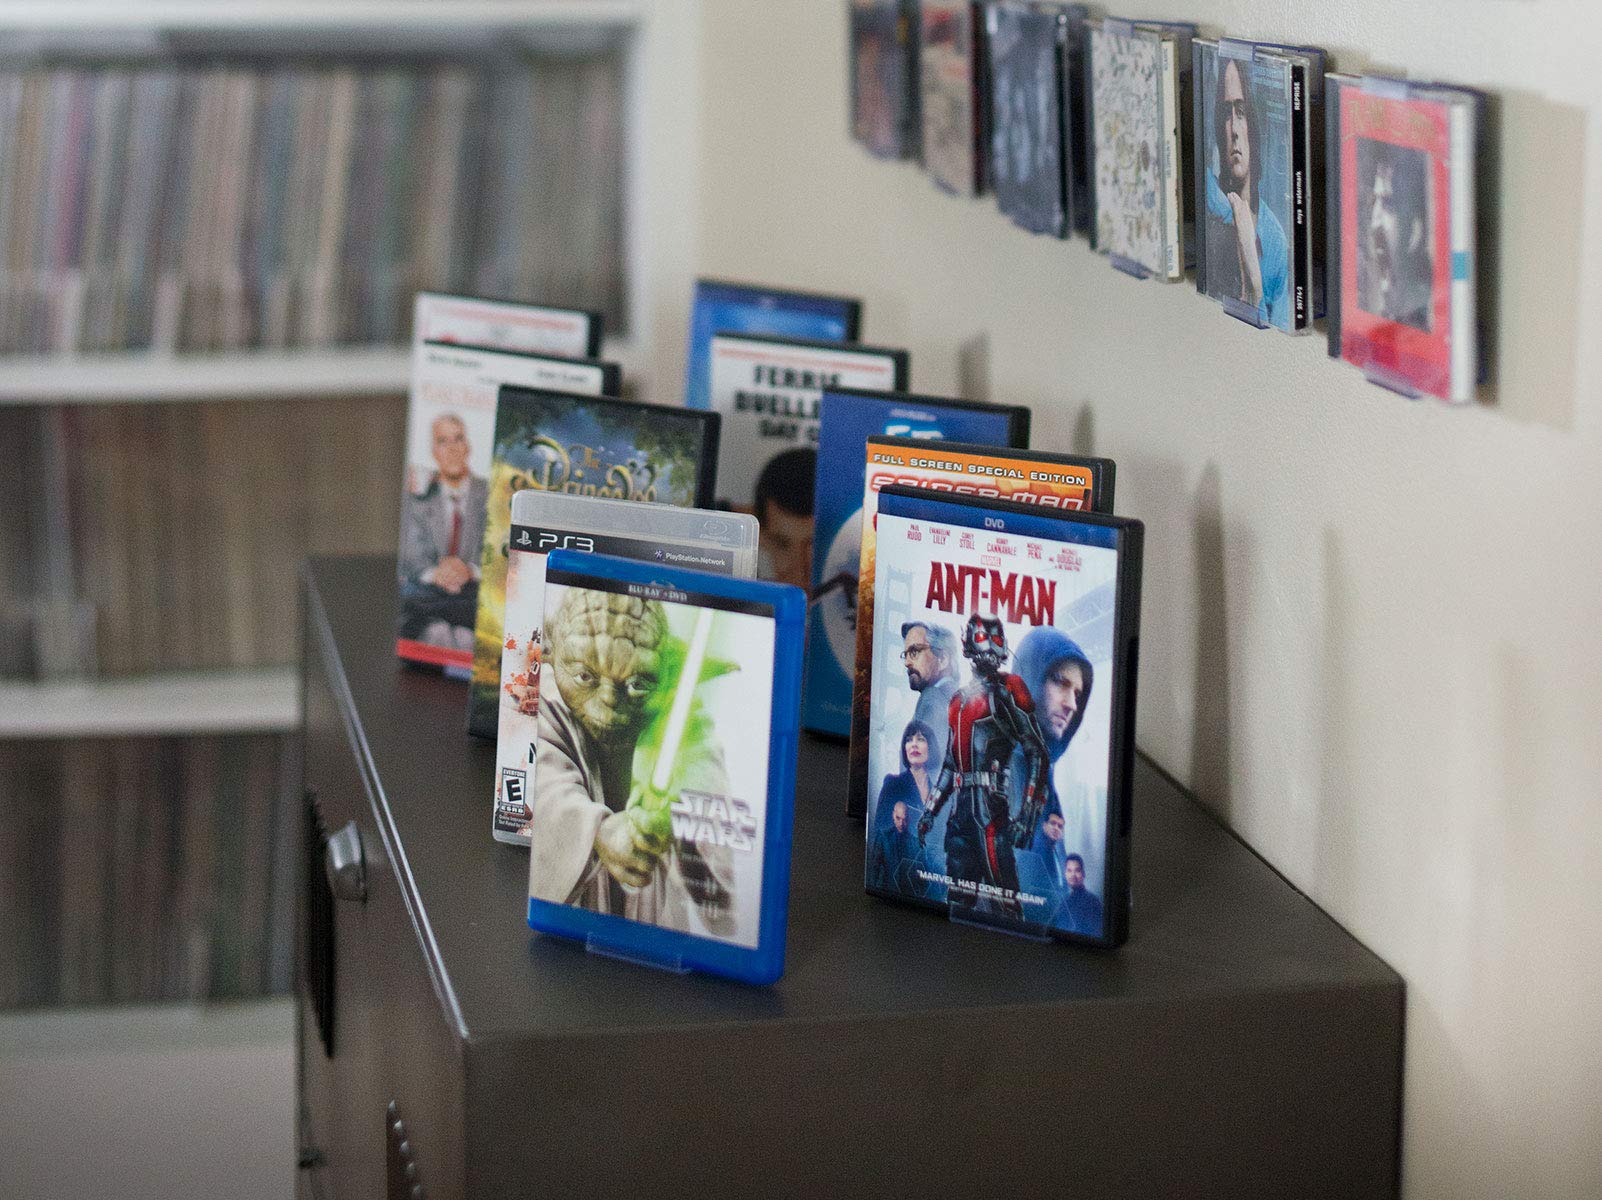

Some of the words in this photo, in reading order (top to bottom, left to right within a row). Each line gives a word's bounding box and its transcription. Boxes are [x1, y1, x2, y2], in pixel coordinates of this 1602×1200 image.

[873, 453, 905, 465] FULL
[909, 458, 963, 472] SCREEN
[967, 464, 1025, 479] SPECIAL
[1030, 471, 1086, 486] EDITION
[984, 517, 1005, 529] DVD
[539, 532, 594, 553] PS3
[907, 530, 922, 542] RUDD
[932, 534, 947, 545] LILLY
[959, 538, 975, 550] STOLL
[925, 561, 1057, 627] ANT-MAN
[506, 779, 523, 802] E
[670, 788, 757, 827] STAR
[671, 812, 756, 851] WARS
[957, 878, 977, 890] HAS
[978, 883, 1003, 896] DONE
[1004, 888, 1014, 899] IT
